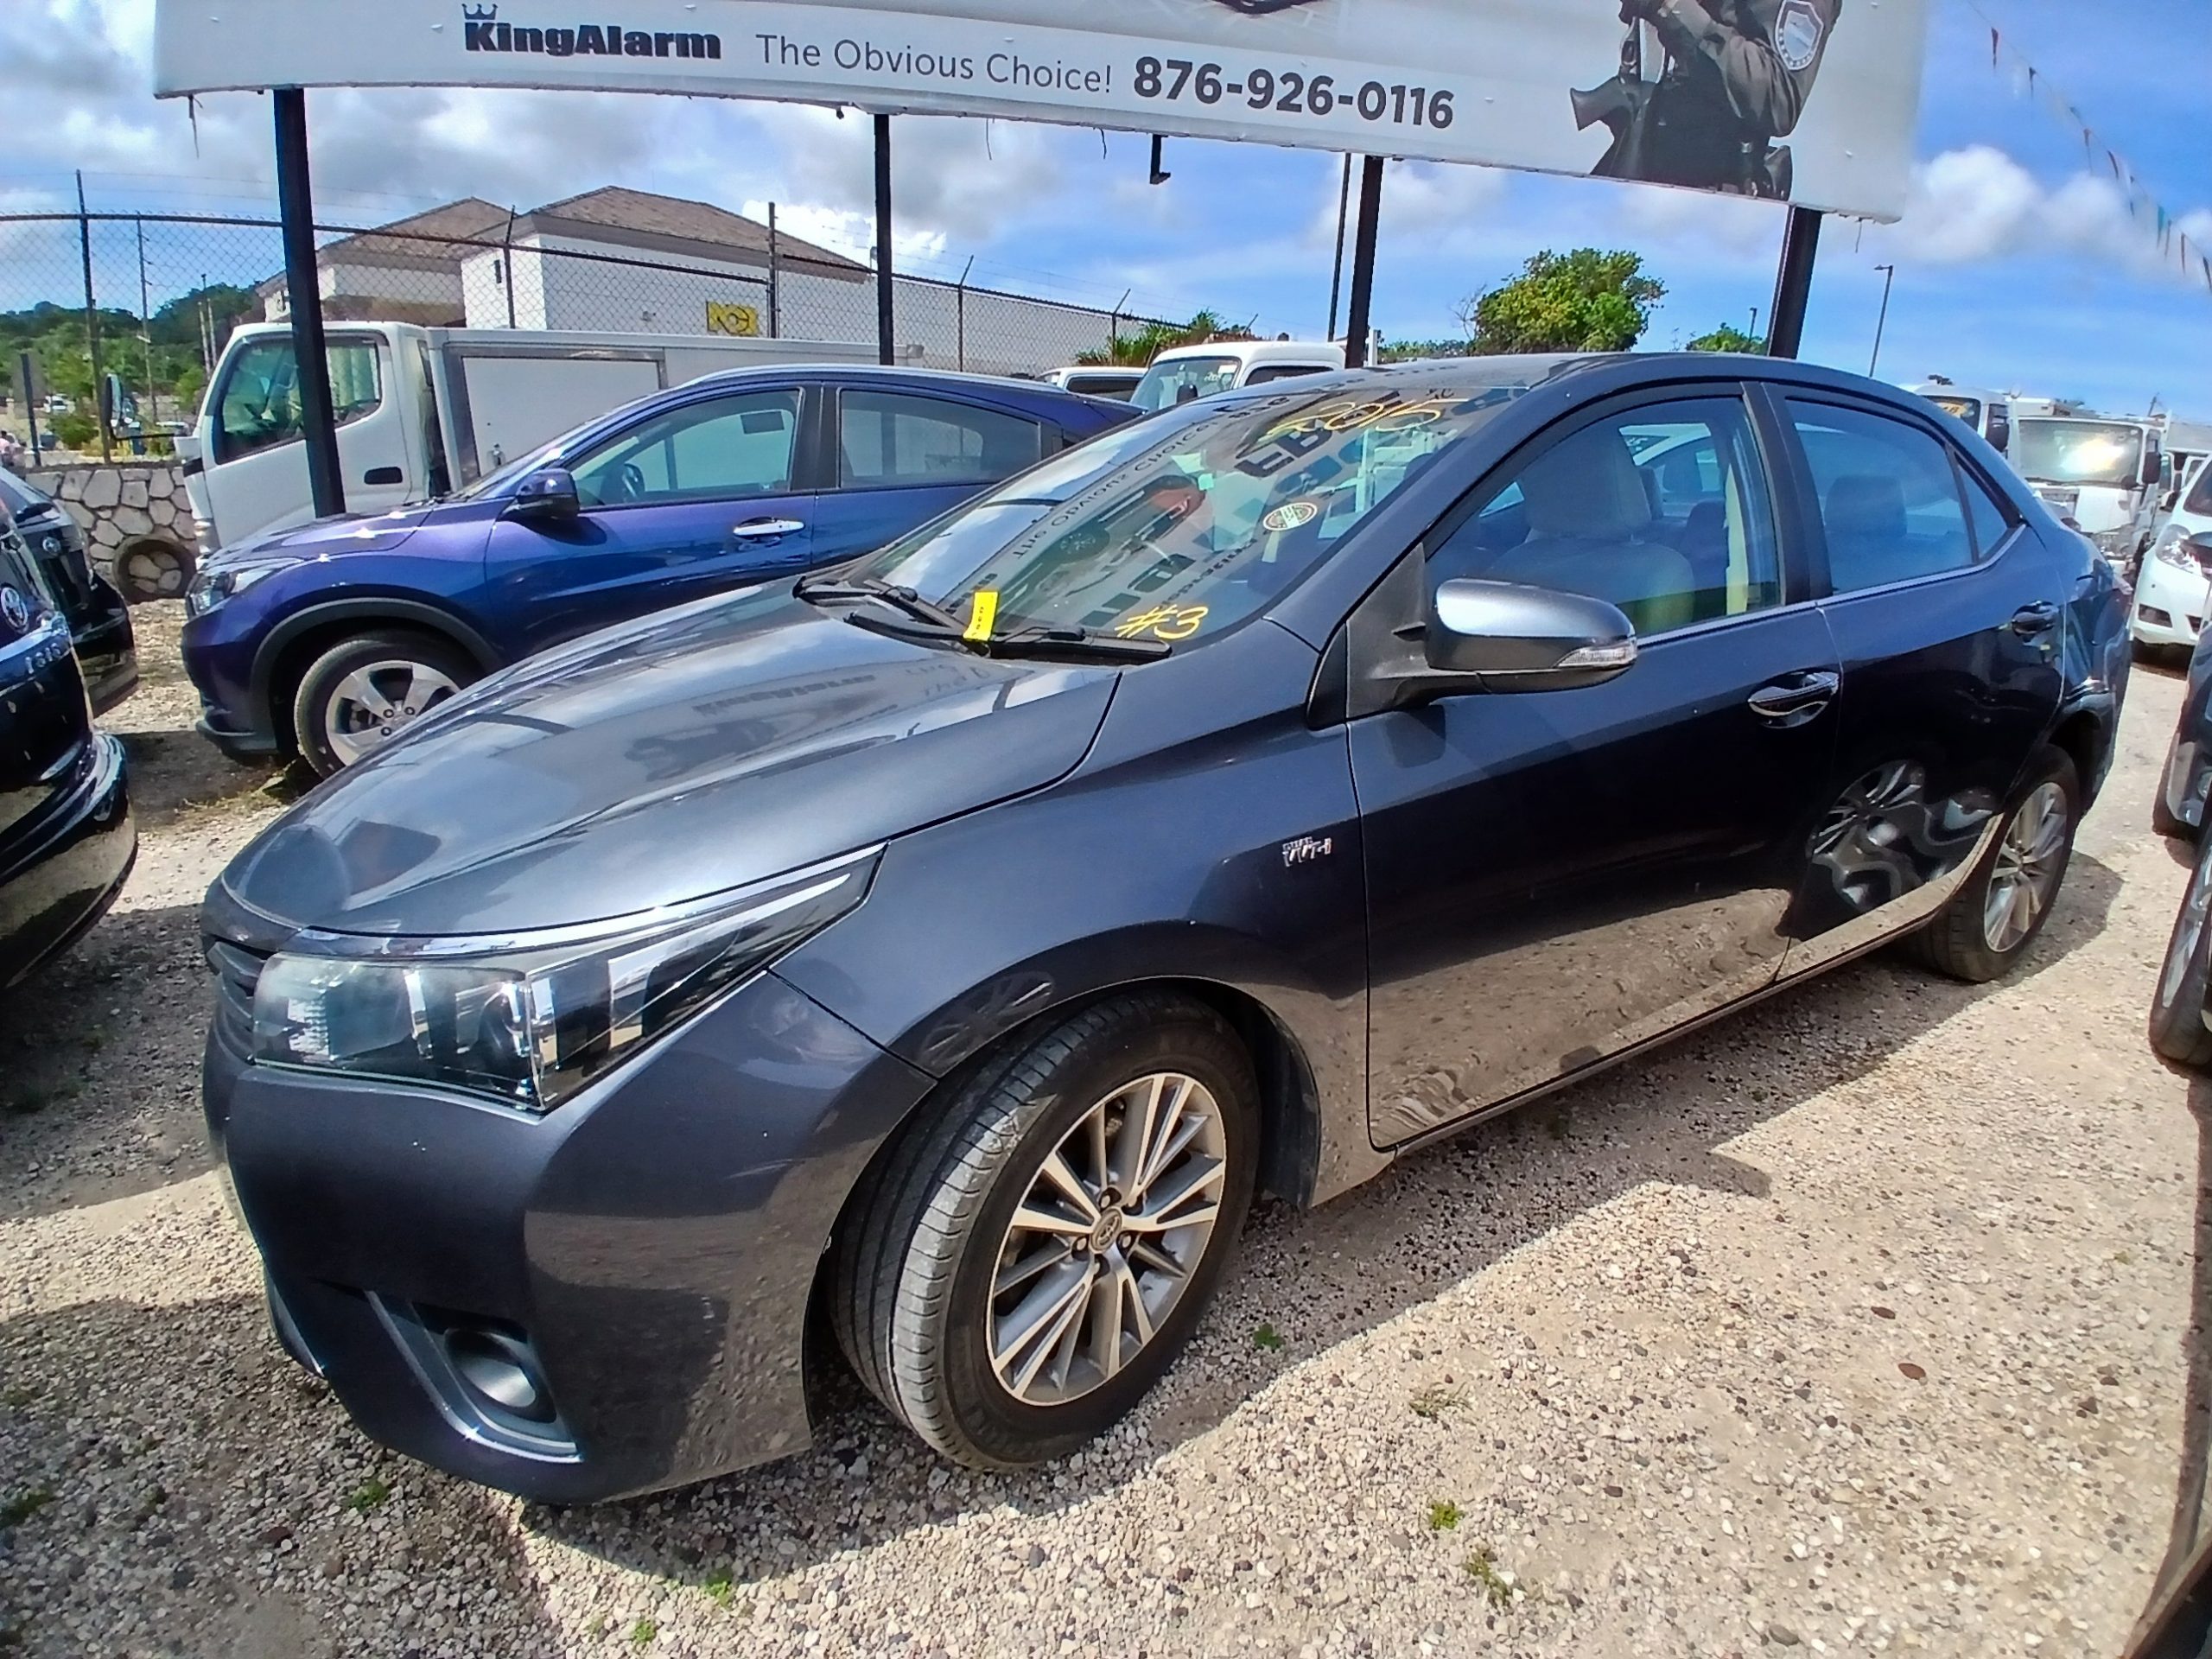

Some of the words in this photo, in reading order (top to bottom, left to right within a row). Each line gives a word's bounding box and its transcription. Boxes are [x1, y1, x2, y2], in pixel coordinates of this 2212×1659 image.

[464, 22, 721, 60] KingAlarm
[755, 34, 821, 67] The
[834, 39, 974, 79] Obvious
[986, 53, 1112, 93] Choice!
[1134, 55, 1454, 130] 876-926-0116
[1114, 604, 1209, 639] #3
